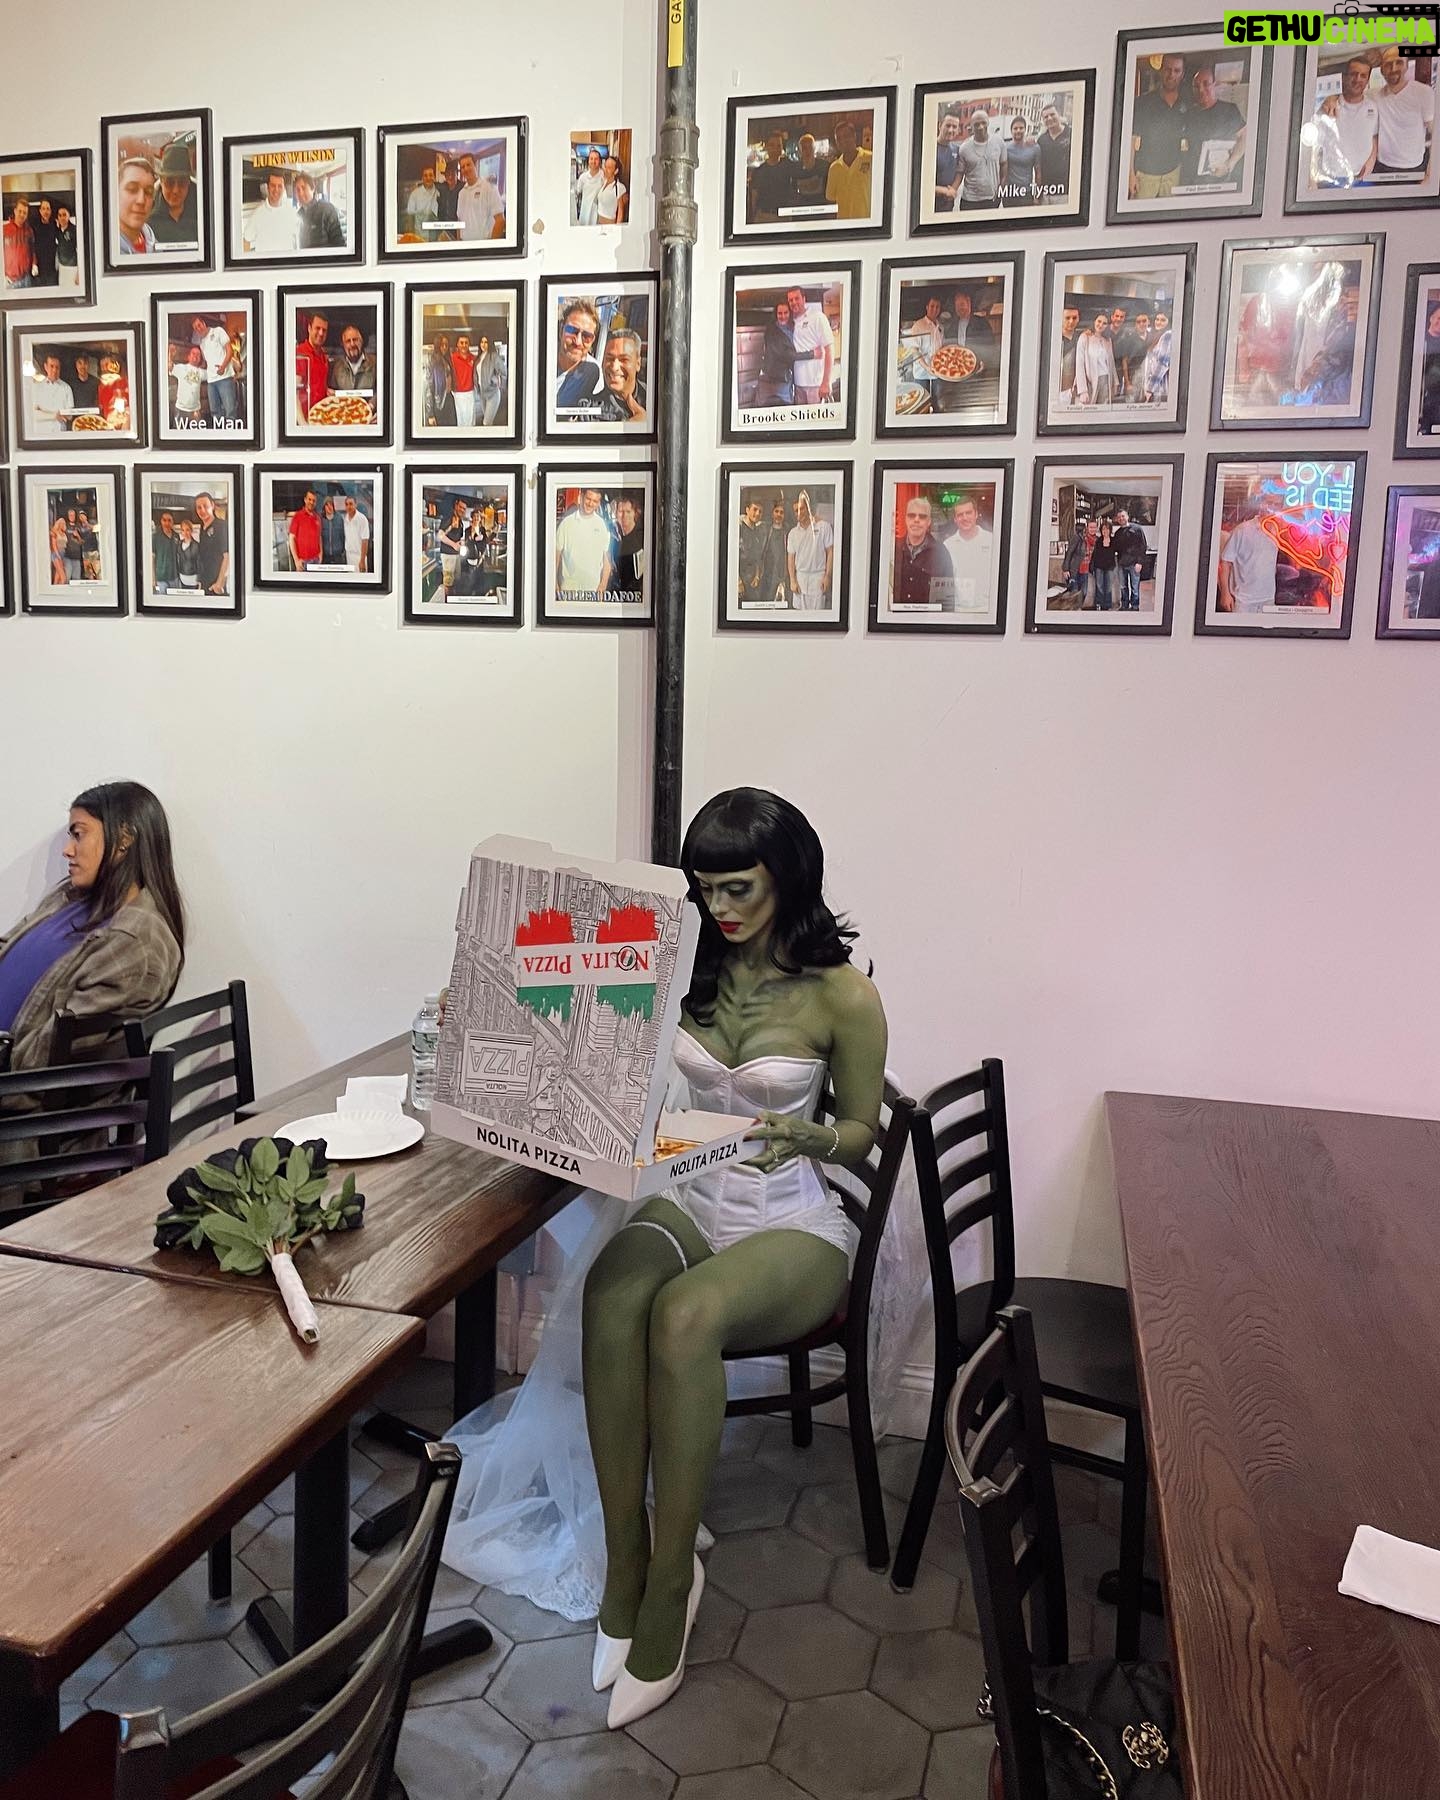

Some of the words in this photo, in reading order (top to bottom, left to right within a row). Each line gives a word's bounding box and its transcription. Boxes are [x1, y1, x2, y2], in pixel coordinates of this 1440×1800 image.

[288, 148, 335, 164] WILSON
[1030, 182, 1065, 199] Tyson
[174, 416, 207, 430] Wee
[213, 416, 244, 430] Man
[743, 412, 786, 424] Brooke
[790, 408, 835, 421] Shields
[604, 590, 642, 603] DAFOE
[469, 1046, 532, 1077] PIZZA
[486, 1081, 508, 1091] NOLITA
[476, 1126, 531, 1158] NOLITA
[535, 1146, 582, 1176] PIZZA
[669, 1153, 707, 1179] NOLITA
[709, 1141, 738, 1164] PIZZA
